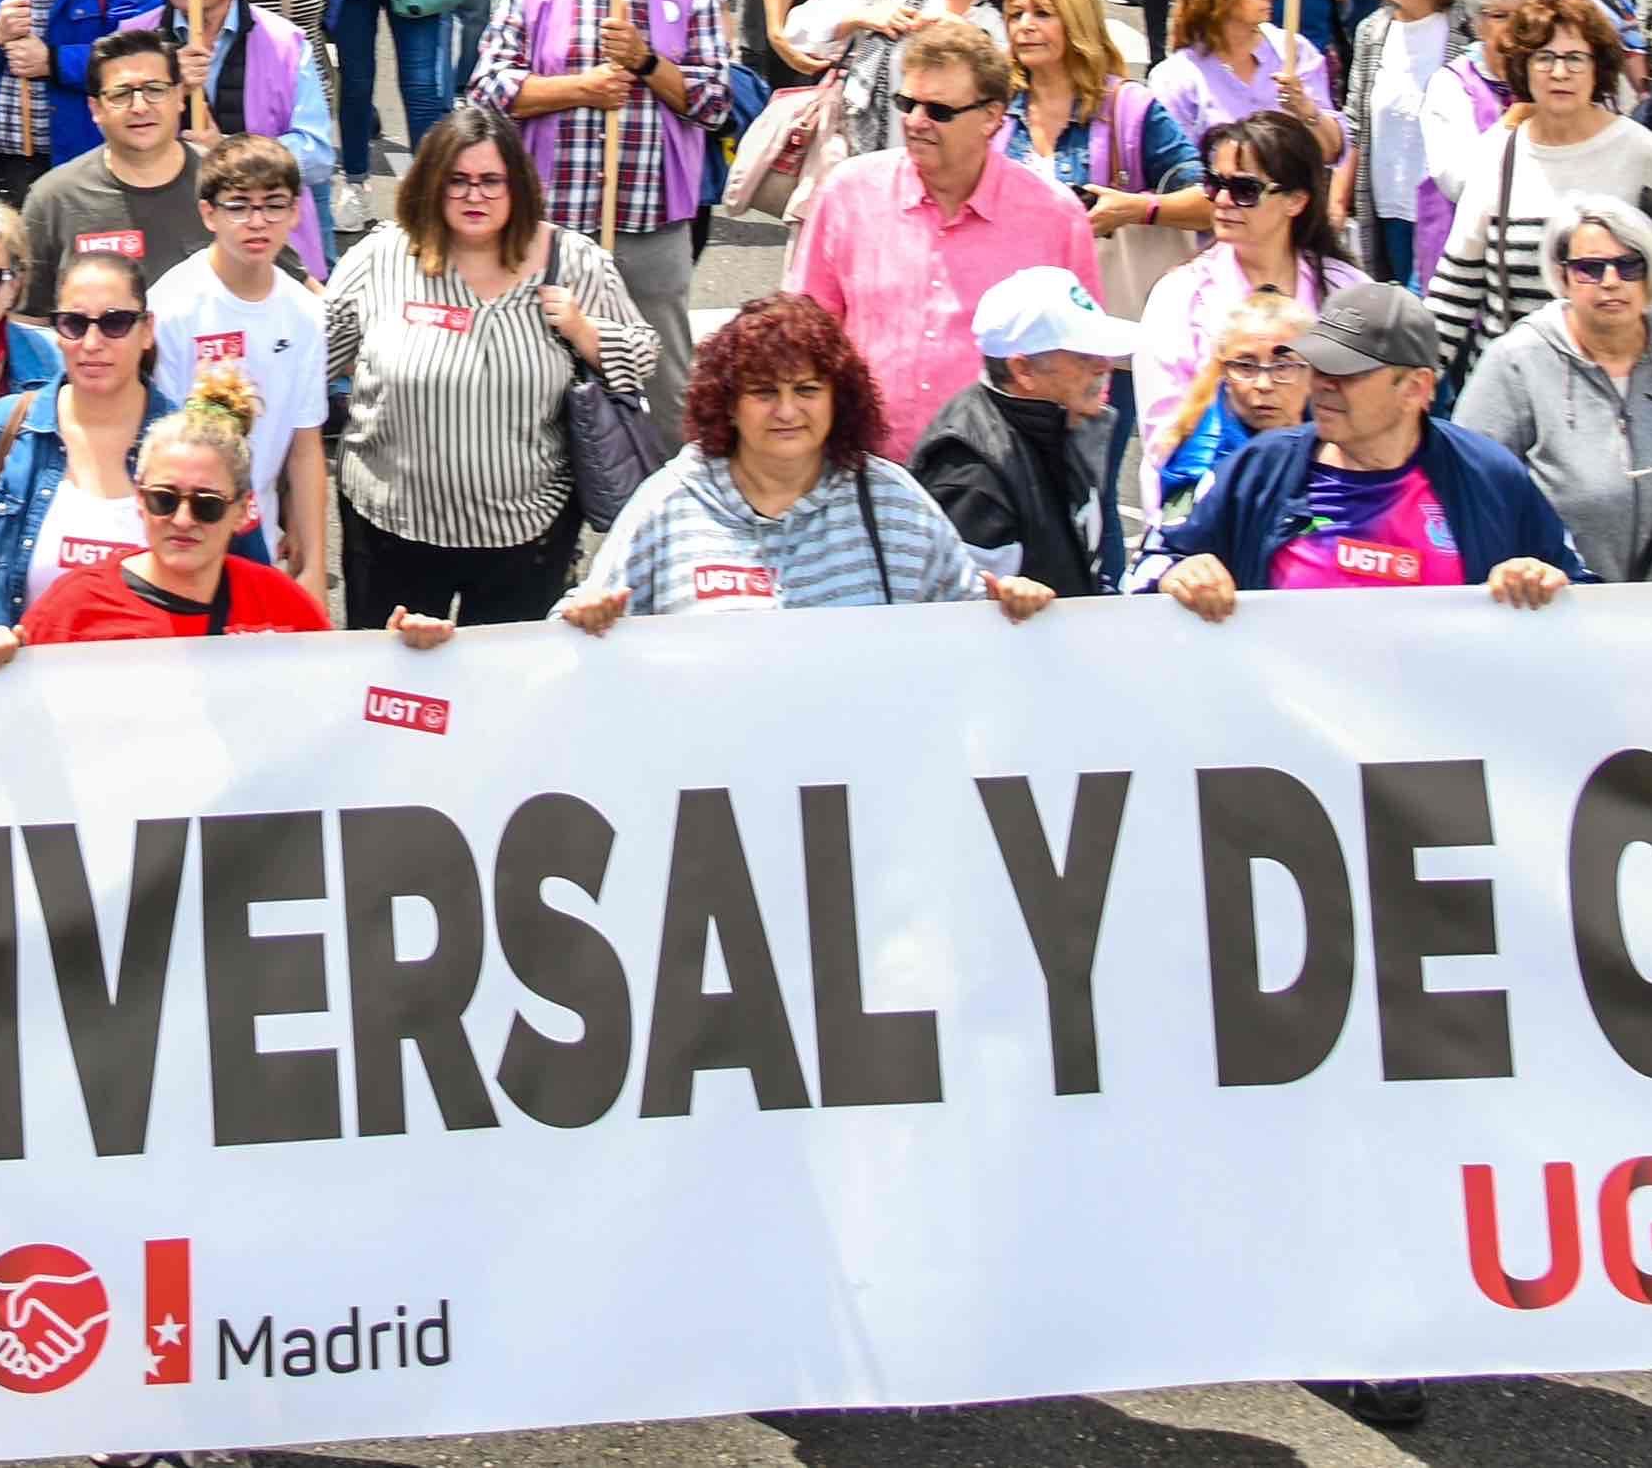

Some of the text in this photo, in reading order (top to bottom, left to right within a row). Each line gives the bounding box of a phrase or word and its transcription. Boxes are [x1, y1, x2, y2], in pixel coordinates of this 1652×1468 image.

[62, 541, 112, 565] UGT
[1338, 543, 1394, 574] UGT
[697, 569, 747, 593] UGT
[368, 692, 422, 724] UGT
[975, 771, 1132, 1096] Y
[1195, 757, 1516, 1090] DE
[216, 1299, 452, 1383] Madrid
